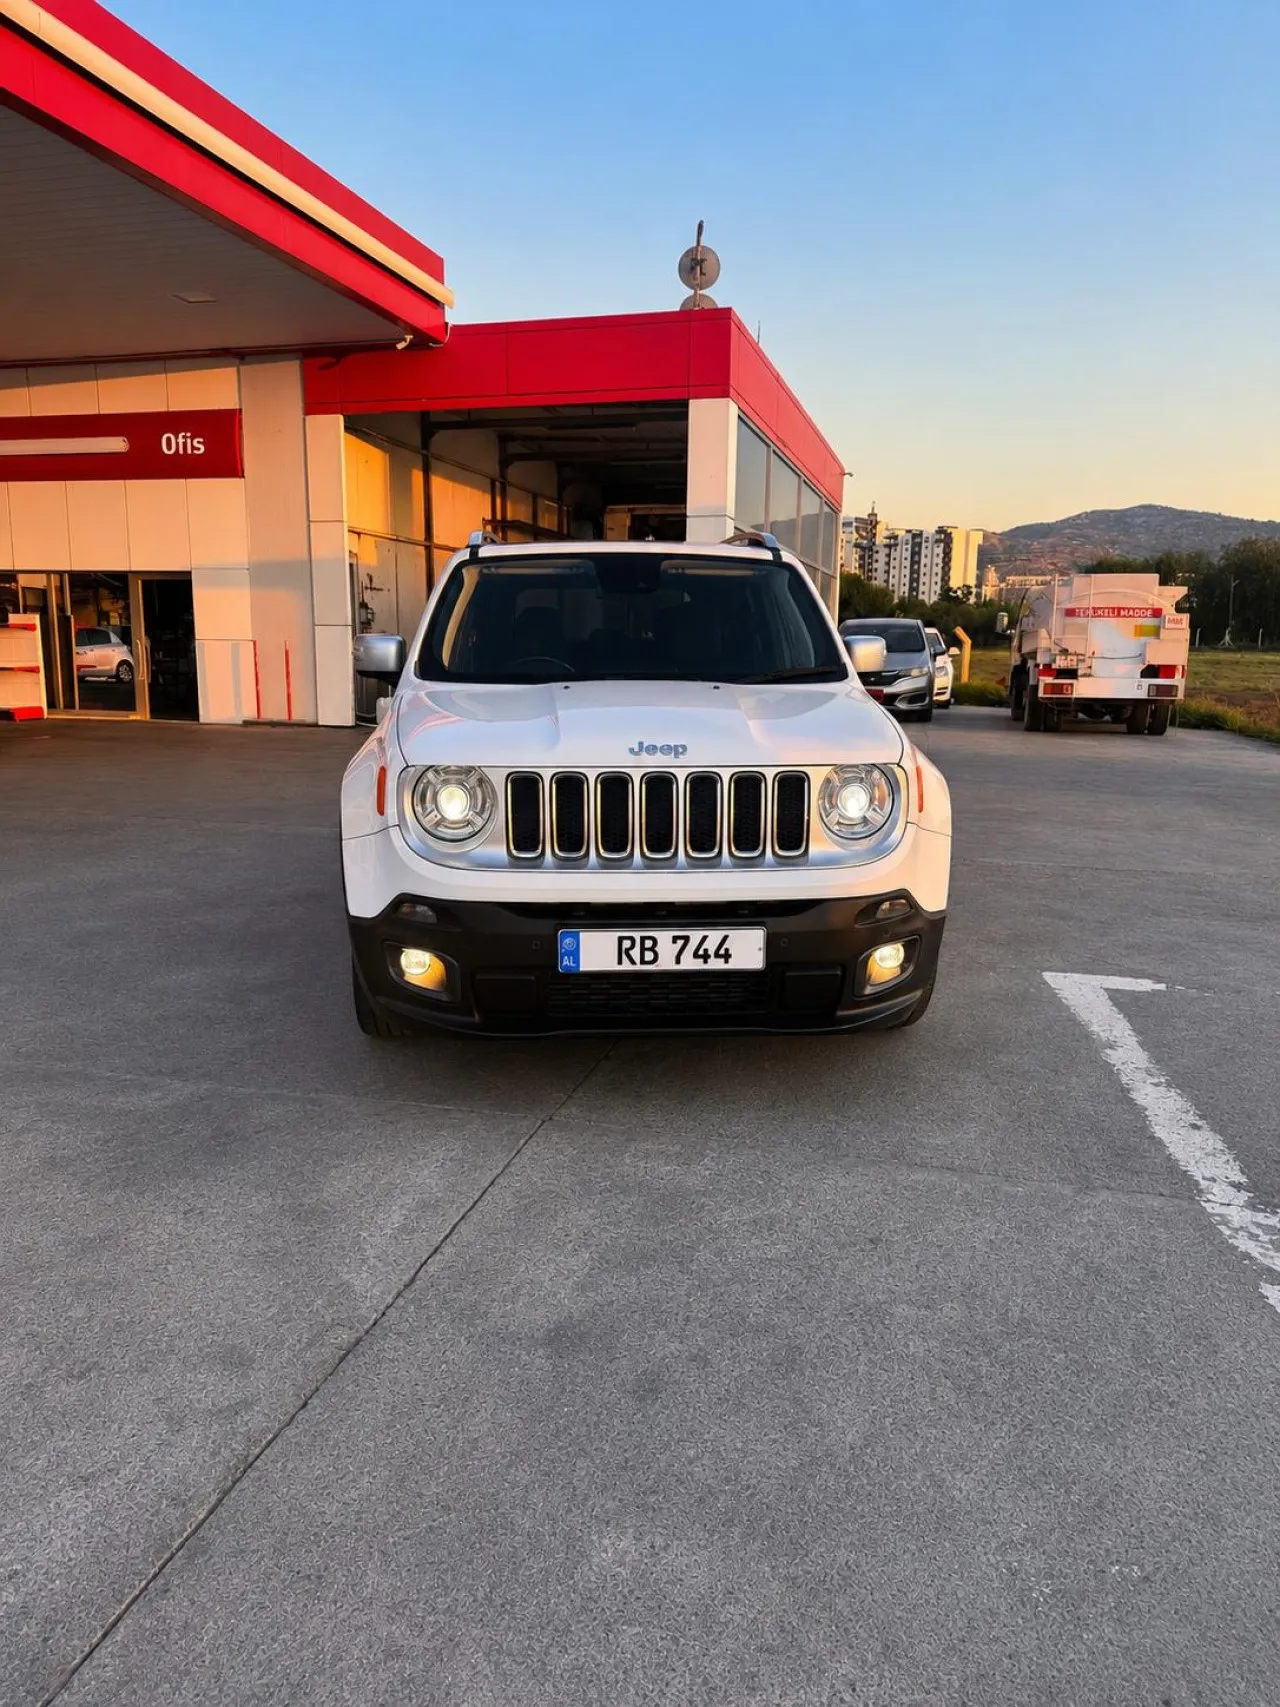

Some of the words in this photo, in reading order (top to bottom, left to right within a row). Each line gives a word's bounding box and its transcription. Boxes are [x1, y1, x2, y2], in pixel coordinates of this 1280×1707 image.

[161, 432, 205, 455] Ofis
[1120, 608, 1153, 617] MADDE
[628, 741, 688, 759] Jeep
[616, 935, 660, 966] RB
[671, 934, 733, 965] 744
[562, 955, 577, 967] AL
